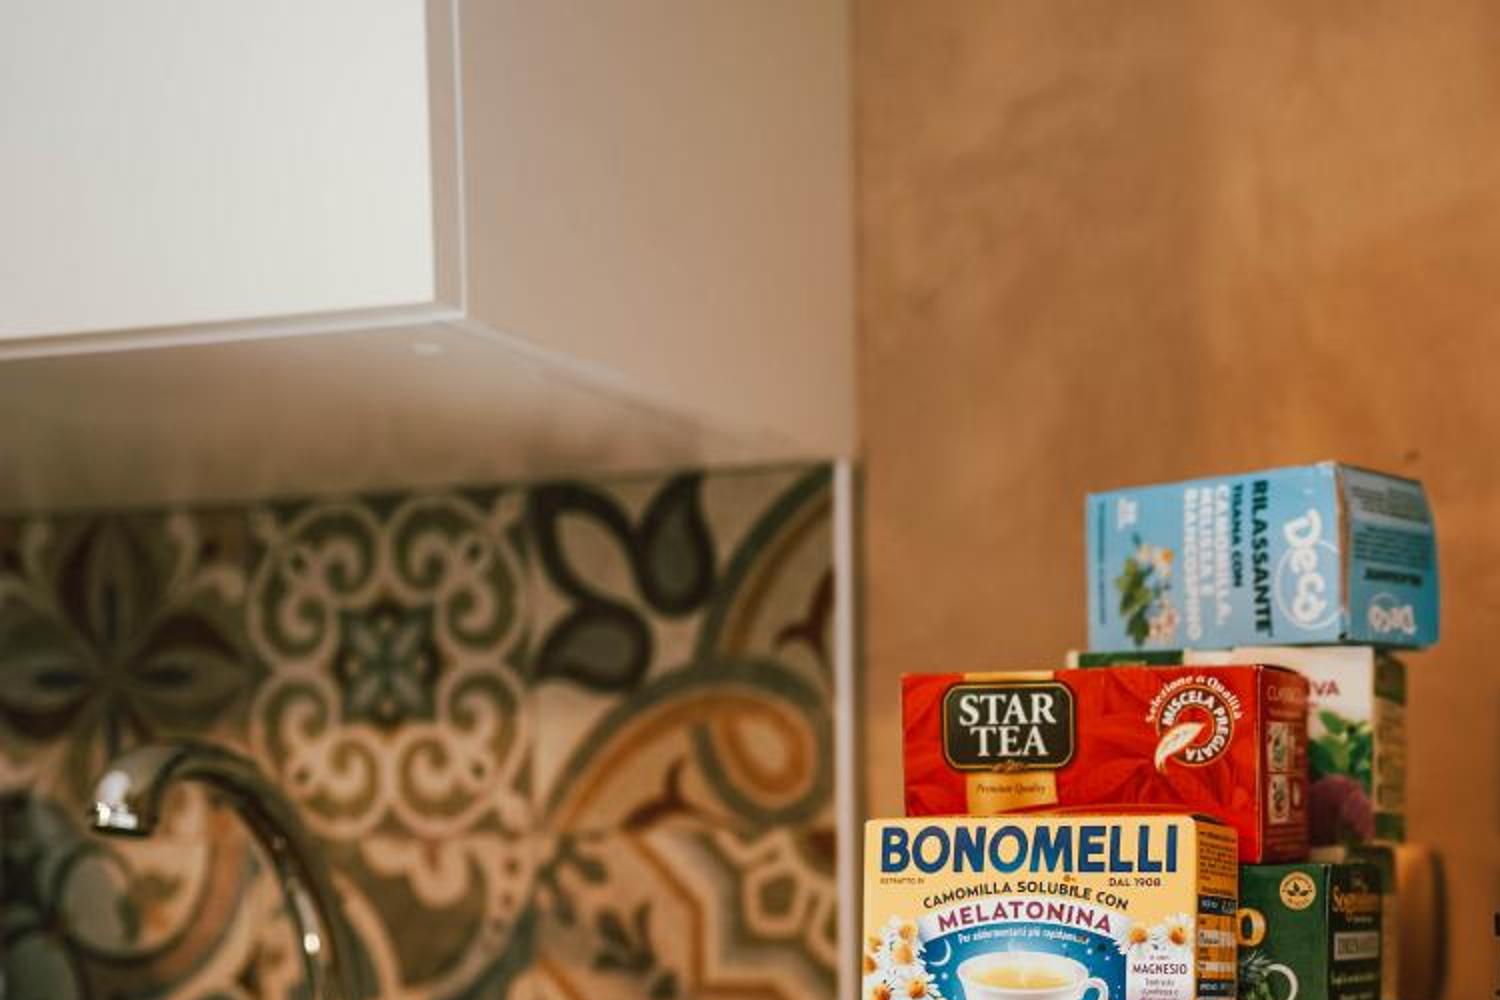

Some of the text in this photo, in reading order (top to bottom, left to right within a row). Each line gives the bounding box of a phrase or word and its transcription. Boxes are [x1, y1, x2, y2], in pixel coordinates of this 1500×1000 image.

[1252, 480, 1273, 634] RILASSANTE
[959, 693, 1056, 726] STAR
[969, 725, 1049, 757] TEA
[1161, 690, 1229, 762] MISCELA PREGIATA
[880, 825, 1178, 873] BONOMELLI
[923, 881, 1129, 911] CAMOMILLA SOLUBILE CON
[1109, 878, 1162, 887] DAL 1908
[937, 901, 1112, 933] MELATONINA
[1132, 963, 1187, 975] MAGNESIO
